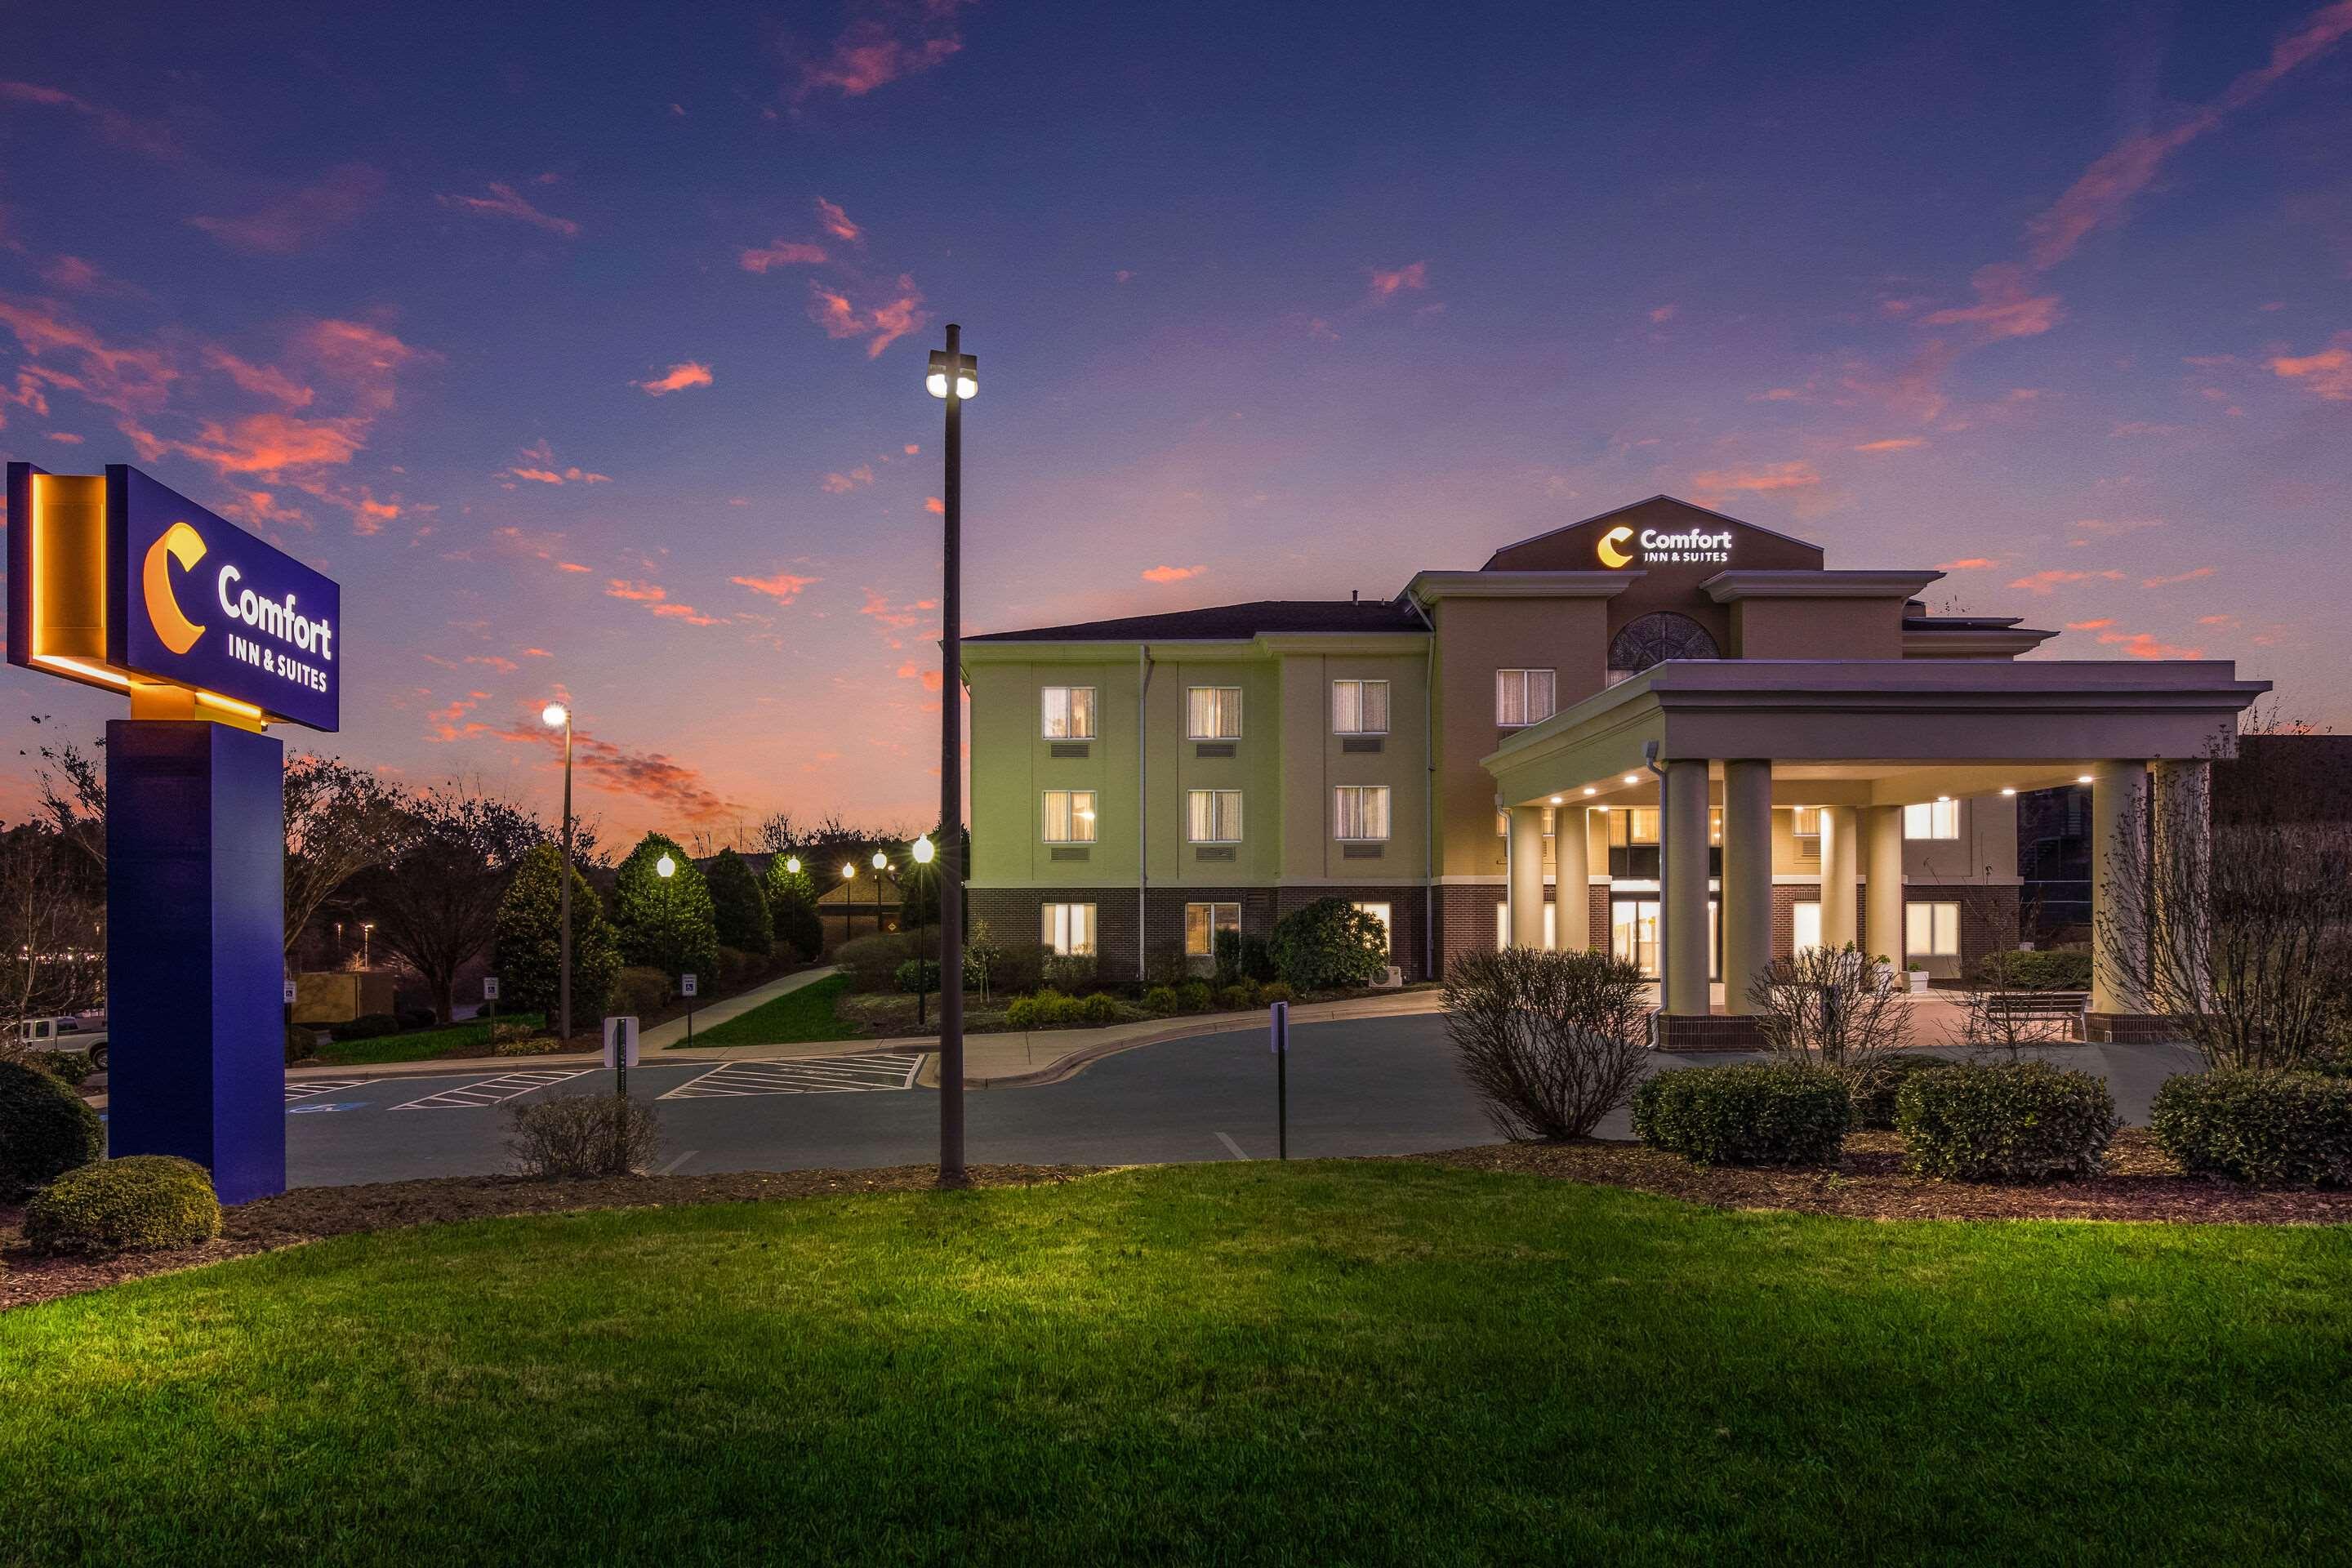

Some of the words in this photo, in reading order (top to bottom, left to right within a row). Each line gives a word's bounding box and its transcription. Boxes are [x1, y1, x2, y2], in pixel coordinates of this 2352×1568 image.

[1640, 528, 1732, 550] Comfort
[1644, 552, 1668, 563] INN
[1671, 552, 1681, 562] &
[1683, 552, 1728, 563] SUITES
[218, 564, 332, 661] Comfort
[229, 633, 260, 667] INN
[263, 648, 275, 673] &
[277, 654, 327, 693] SUITES
